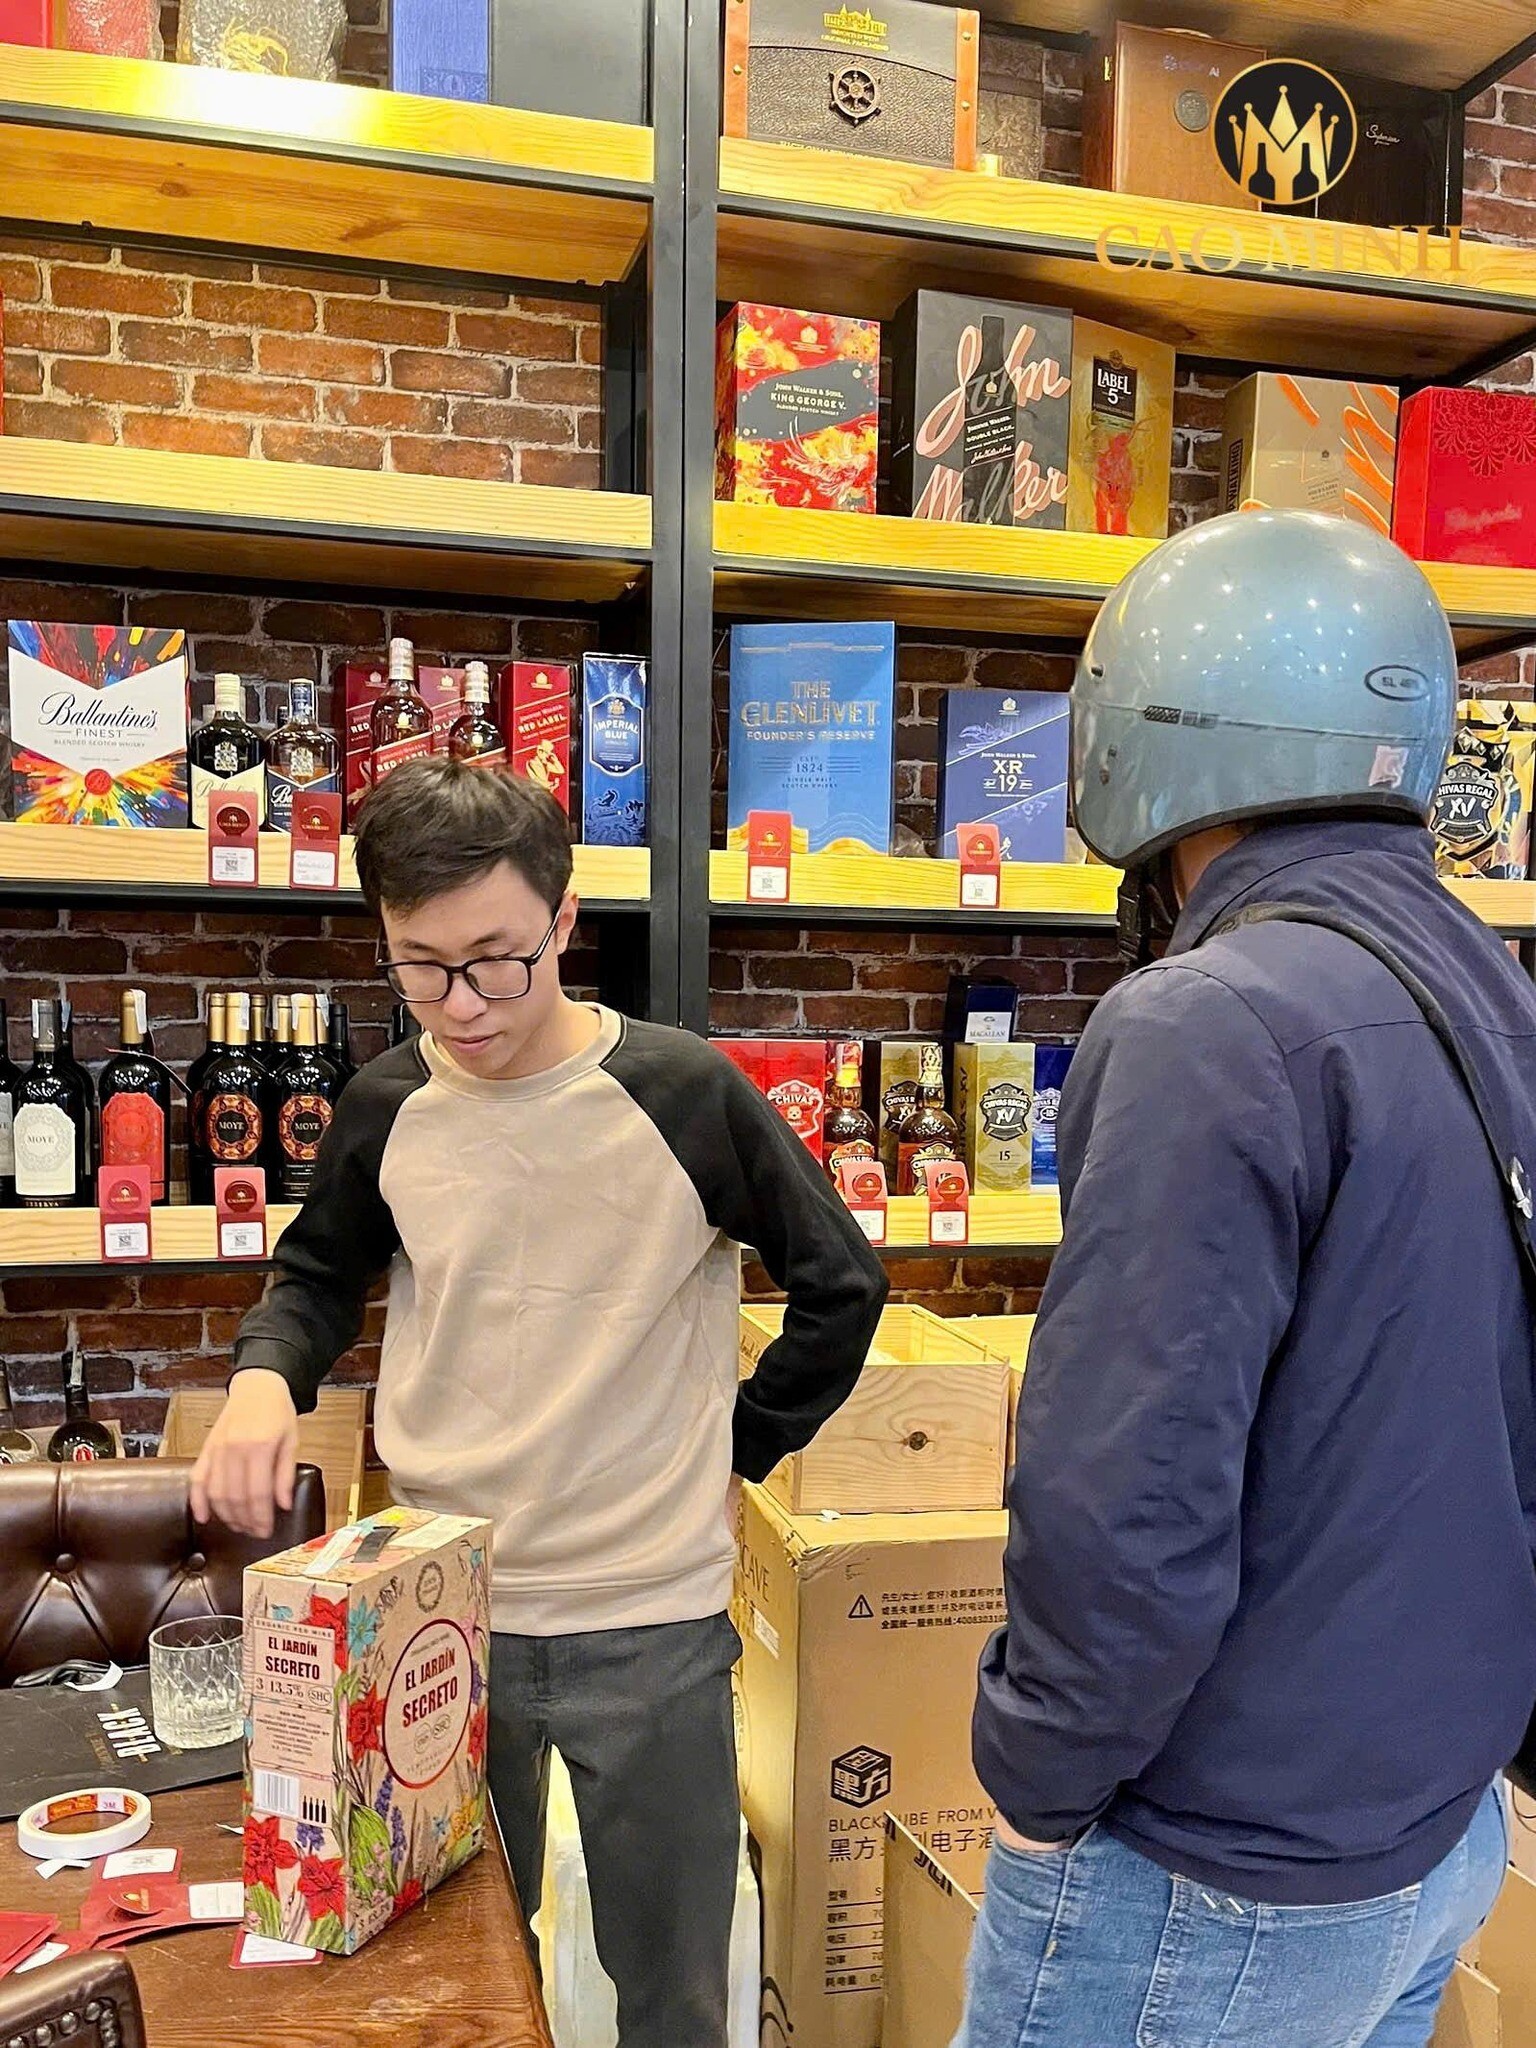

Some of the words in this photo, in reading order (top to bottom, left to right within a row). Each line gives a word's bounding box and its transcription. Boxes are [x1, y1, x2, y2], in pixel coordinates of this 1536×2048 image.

[1097, 368, 1131, 394] LABEL
[770, 392, 795, 403] KING
[796, 395, 836, 409] GEORGE
[1107, 388, 1118, 405] 5
[790, 681, 831, 699] THE
[38, 691, 158, 729] Ballantine's
[740, 701, 881, 728] GLENLIVET
[75, 728, 123, 739] FINEST
[350, 721, 370, 734] RED
[518, 722, 536, 733] RED
[593, 719, 640, 734] IMPERIAL
[605, 730, 628, 740] BLUE
[746, 730, 816, 741] FOUNDER'S
[818, 730, 876, 741] RESERVE
[376, 760, 398, 772] RED
[795, 763, 824, 774] 1824
[999, 774, 1018, 792] 19
[1437, 783, 1465, 797] HIVAS
[1464, 784, 1494, 800] REGAL
[1449, 797, 1477, 819] XV
[775, 1093, 814, 1106] CHIVAS
[982, 1099, 1008, 1110] CHIVAS
[1007, 1099, 1029, 1109] REGAL
[995, 1108, 1016, 1125] XV
[218, 1120, 245, 1131] MOYE
[294, 1121, 320, 1131] MOYE
[27, 1135, 54, 1144] MOYE
[999, 1150, 1011, 1161] 15
[268, 1636, 279, 1651] EL
[282, 1638, 318, 1657] JARDÍN
[265, 1655, 320, 1680] SECRETO
[405, 1669, 417, 1692] EL
[420, 1646, 455, 1684] JARDÍN
[402, 1676, 458, 1728] SECRETO
[96, 1706, 162, 1758] BLACK
[828, 1815, 883, 1833] BLACK
[936, 1808, 983, 1824] FROM
